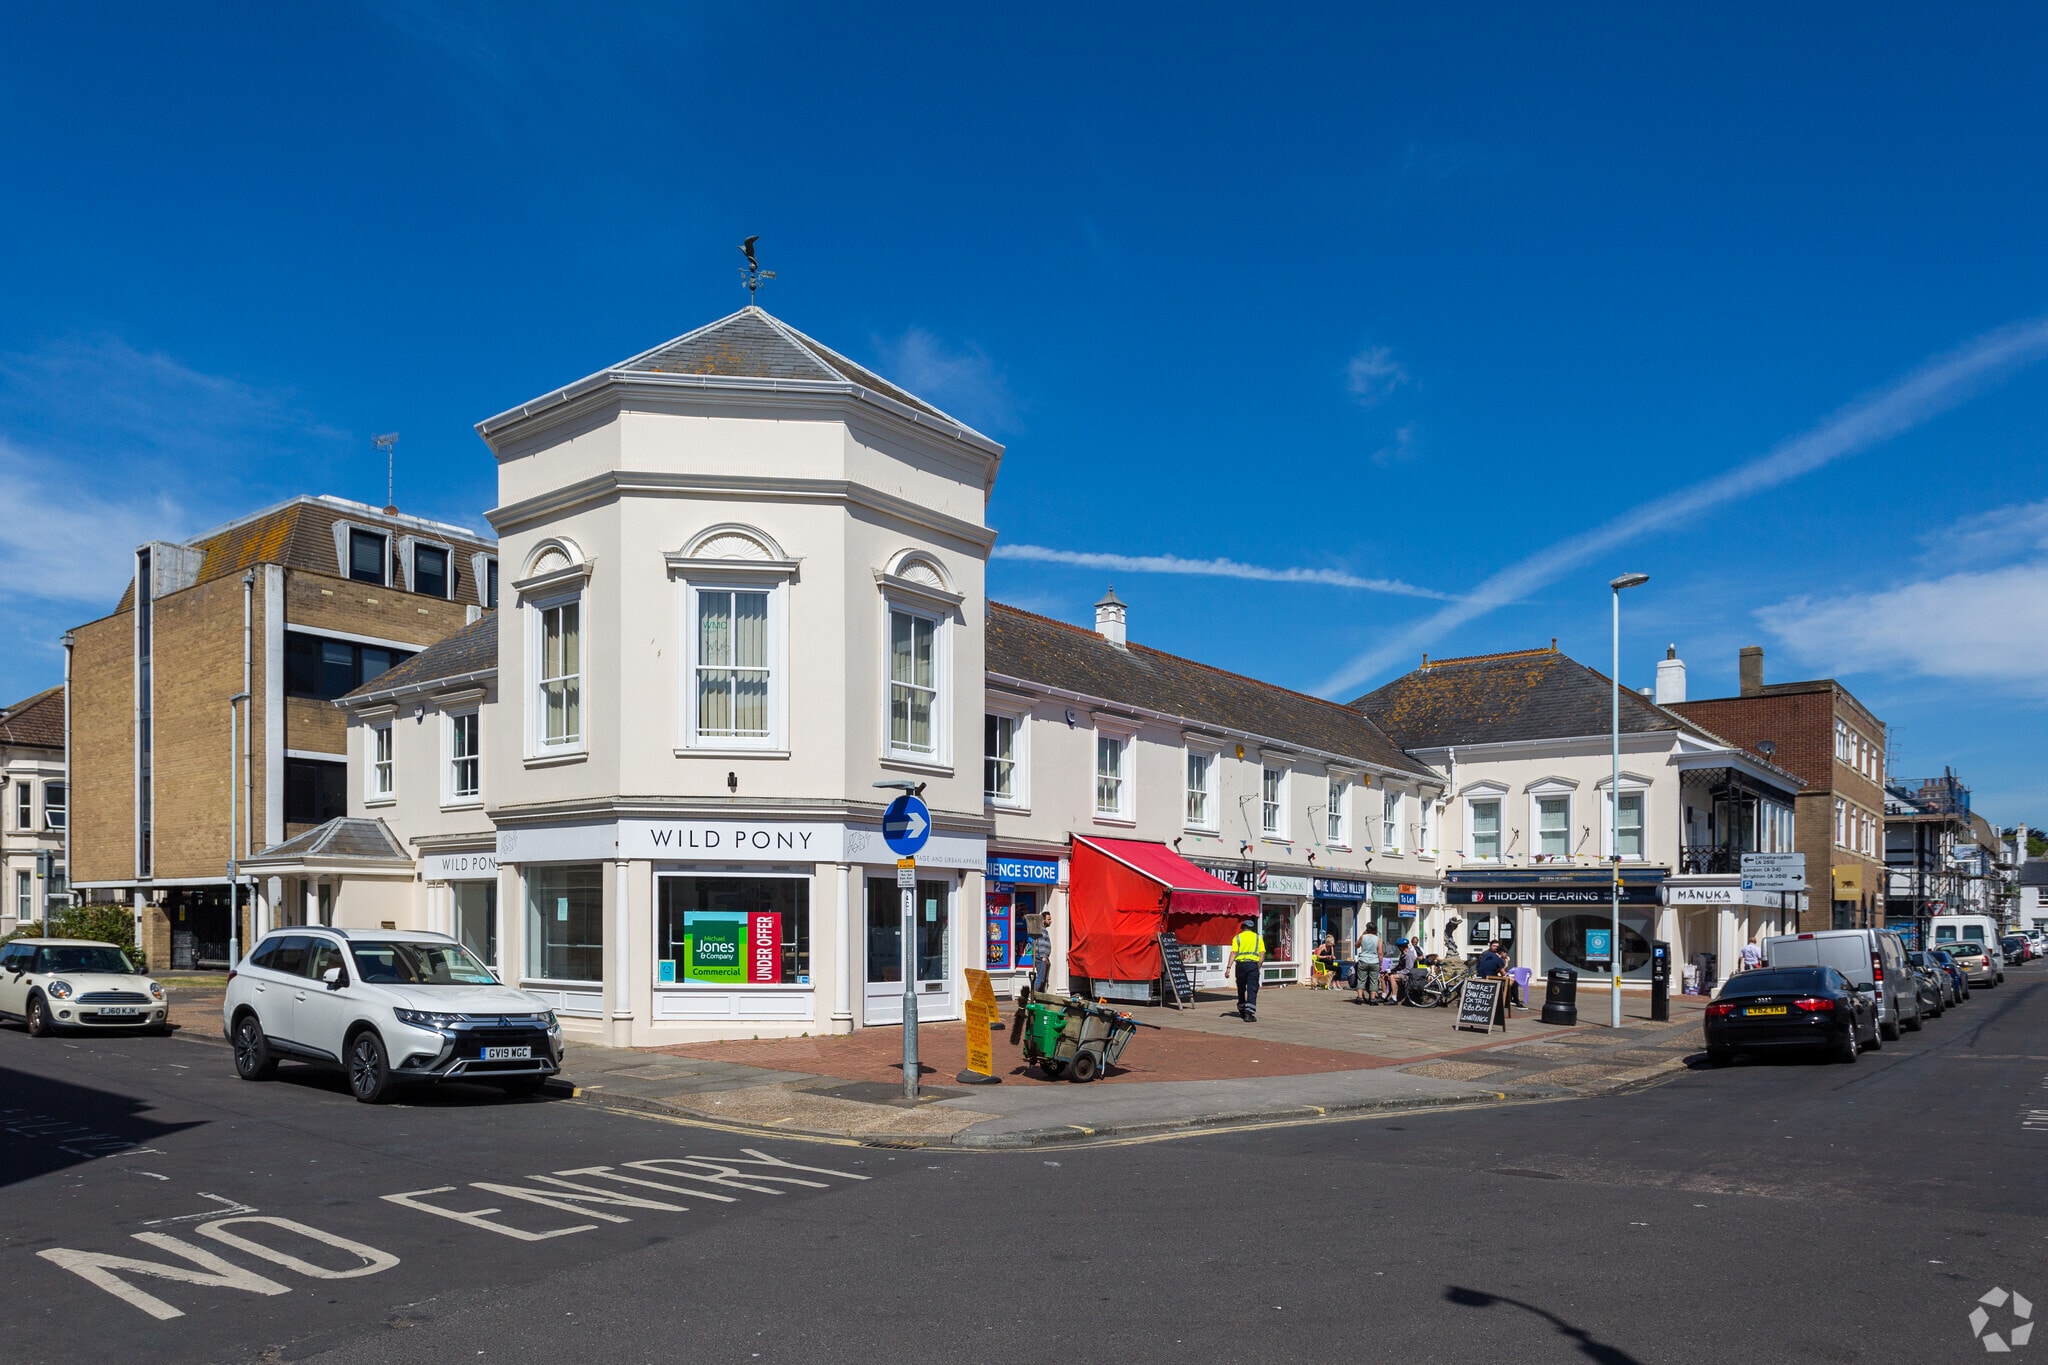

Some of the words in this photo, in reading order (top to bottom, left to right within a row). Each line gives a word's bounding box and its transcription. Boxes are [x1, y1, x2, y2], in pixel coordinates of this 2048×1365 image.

[650, 829, 720, 848] WILD
[735, 830, 813, 850] PONY
[442, 857, 468, 871] WILD
[472, 856, 496, 871] PON
[914, 854, 930, 862] TAGE
[945, 856, 962, 864] URBAN
[962, 858, 983, 866] APPAREL
[1023, 865, 1056, 879] STORE
[1203, 867, 1239, 885] ADEZ
[994, 882, 1001, 892] 2
[1279, 879, 1304, 891] SNAK
[1320, 879, 1329, 893] THE
[1330, 879, 1348, 893] TWISTED
[1400, 895, 1406, 903] To
[1406, 895, 1415, 903] Let
[1488, 892, 1535, 901] HIDDEN
[1539, 892, 1598, 901] HEARING
[757, 916, 773, 947] OFFER
[696, 940, 735, 953] Jones
[706, 953, 734, 961] Company
[757, 948, 773, 981] UNDER
[692, 968, 741, 976] Commercial
[100, 1007, 121, 1015] EJ60
[489, 1048, 509, 1058] GV19
[379, 1148, 873, 1241] ENTRY
[35, 1216, 401, 1321] NO
